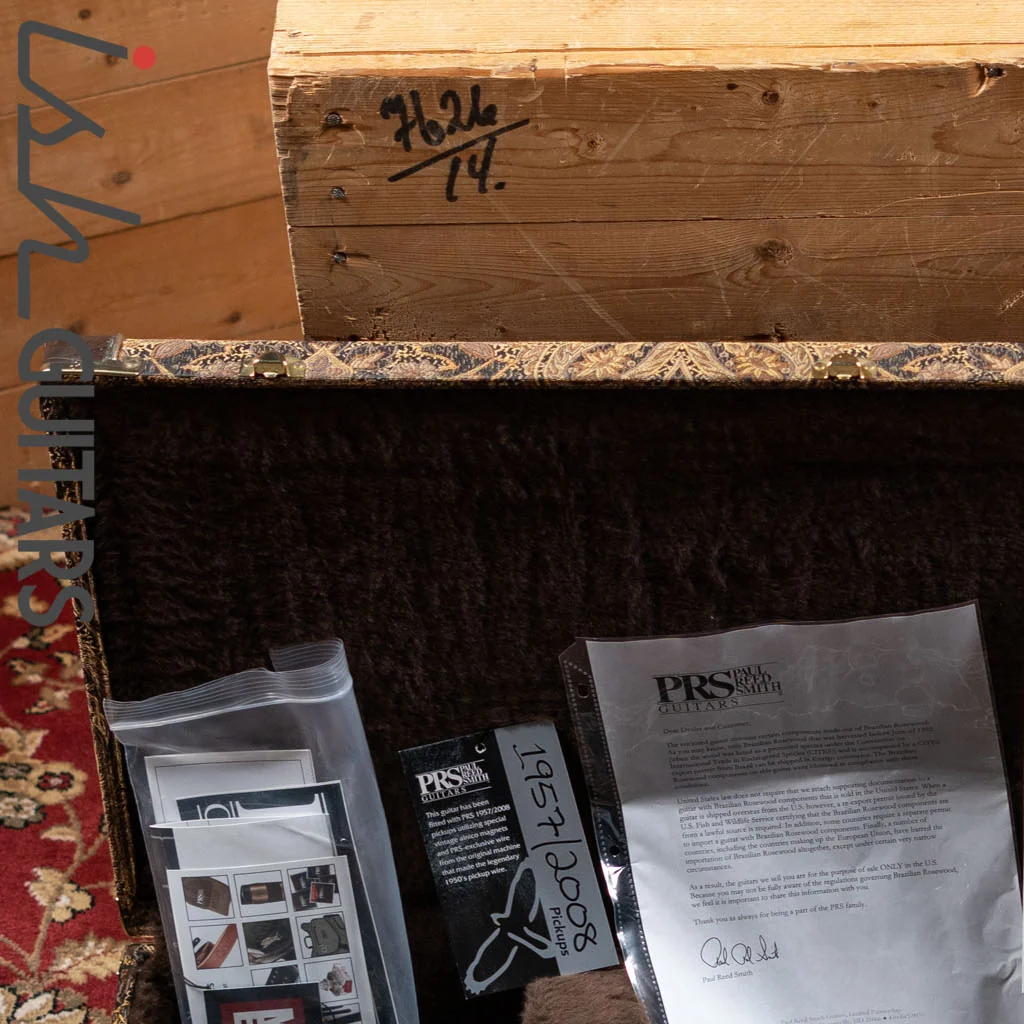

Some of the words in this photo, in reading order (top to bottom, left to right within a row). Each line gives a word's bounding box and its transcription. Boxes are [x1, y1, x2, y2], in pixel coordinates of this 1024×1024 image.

[733, 666, 766, 680] PAUL
[735, 673, 772, 686] REED
[652, 671, 735, 703] PRS
[736, 681, 782, 695] SMITH
[658, 698, 738, 714] GUITARS
[460, 762, 479, 772] PAUL
[462, 768, 483, 778] REED
[416, 766, 463, 795] PRS
[463, 773, 489, 785] SMITH
[421, 787, 467, 801] GUITARS
[428, 819, 446, 828] fitted
[447, 816, 461, 824] with
[476, 804, 510, 817] 1957/2008
[441, 807, 458, 817] guitar
[473, 800, 489, 808] been
[431, 828, 456, 839] pickups
[458, 821, 483, 832] utilizing
[484, 816, 506, 826] special
[434, 837, 458, 847] vintage
[480, 826, 508, 836] magnets
[437, 849, 449, 857] and
[468, 850, 492, 861] original
[493, 843, 520, 853] machine
[456, 864, 474, 873] made
[487, 854, 520, 865] legendary
[468, 870, 490, 881] pickup
[783, 875, 794, 883] you
[831, 869, 856, 877] purpose
[880, 862, 904, 870] ONLY
[690, 891, 718, 899] Because
[768, 884, 781, 892] fully
[860, 874, 892, 883] governing
[893, 870, 920, 878] Brazilian
[728, 896, 760, 905] important
[737, 913, 758, 922] always
[795, 908, 808, 916] part
[550, 907, 569, 957] Pickups
[702, 974, 715, 983] Paul
